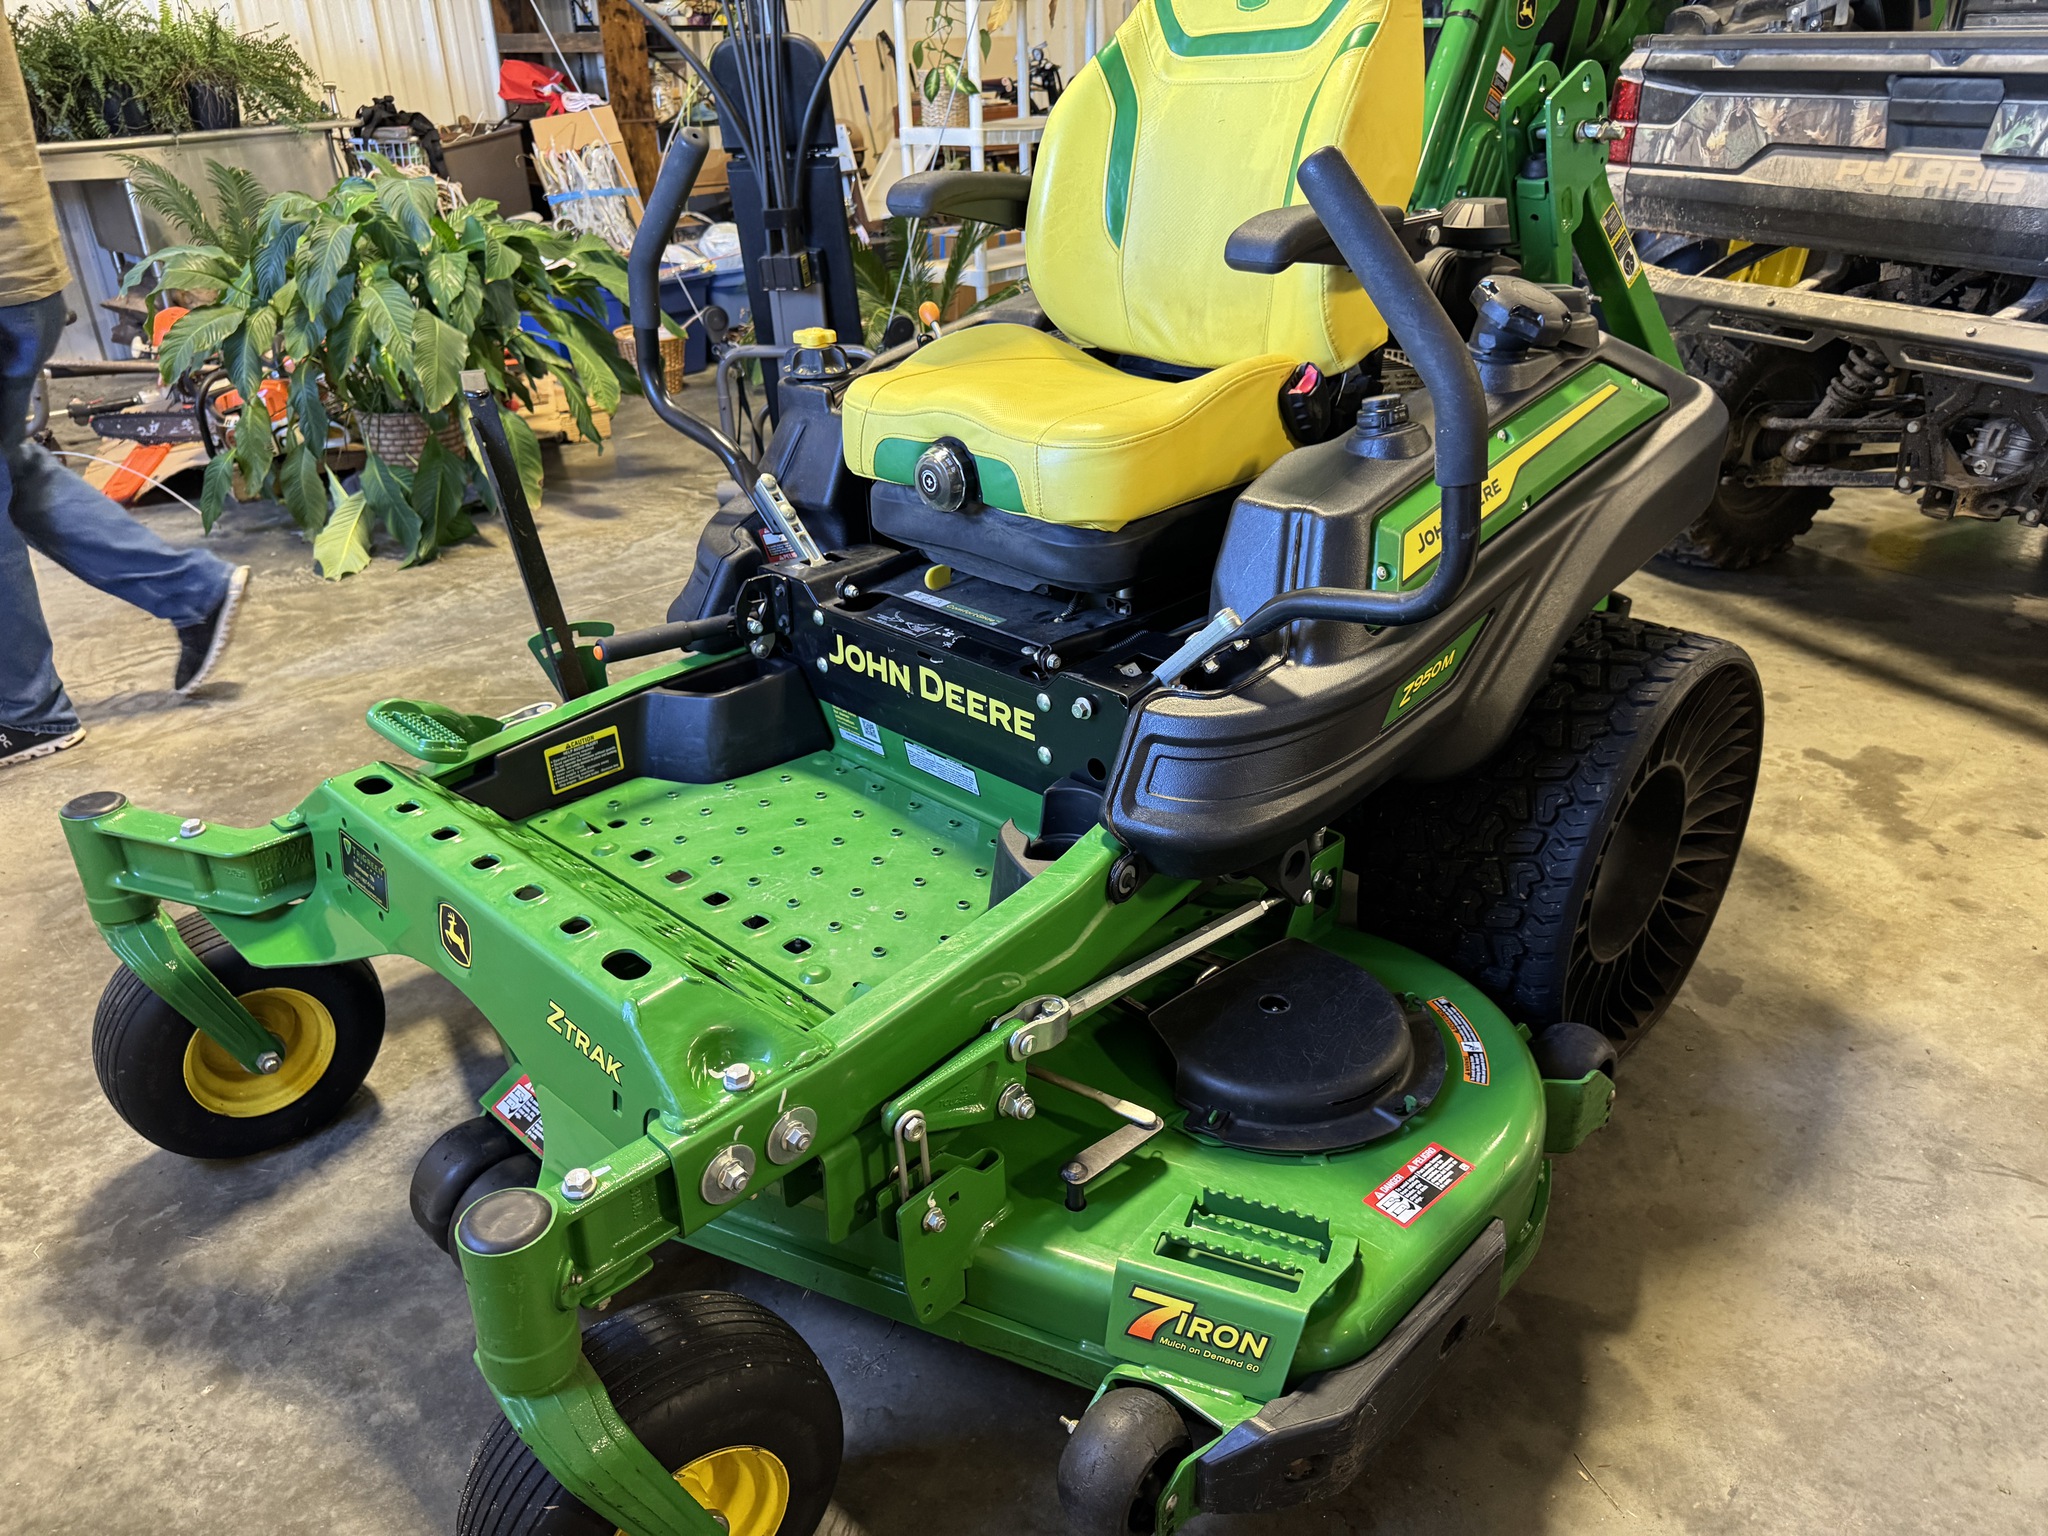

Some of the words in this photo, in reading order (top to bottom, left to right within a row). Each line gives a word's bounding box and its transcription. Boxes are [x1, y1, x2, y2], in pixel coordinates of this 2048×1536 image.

[1835, 158, 2029, 193] POLARIS
[829, 634, 911, 693] JOHN
[919, 665, 1036, 742] DEERE
[1398, 649, 1456, 708] Z950M
[571, 735, 595, 748] CAUTION
[546, 999, 624, 1086] ZTRAK
[1379, 1173, 1405, 1193] DANGER
[1412, 1146, 1437, 1167] PELIGRO
[1159, 1336, 1187, 1351] Mulch
[1189, 1346, 1201, 1356] on
[1203, 1349, 1244, 1369] Demand
[1246, 1362, 1260, 1373] 60
